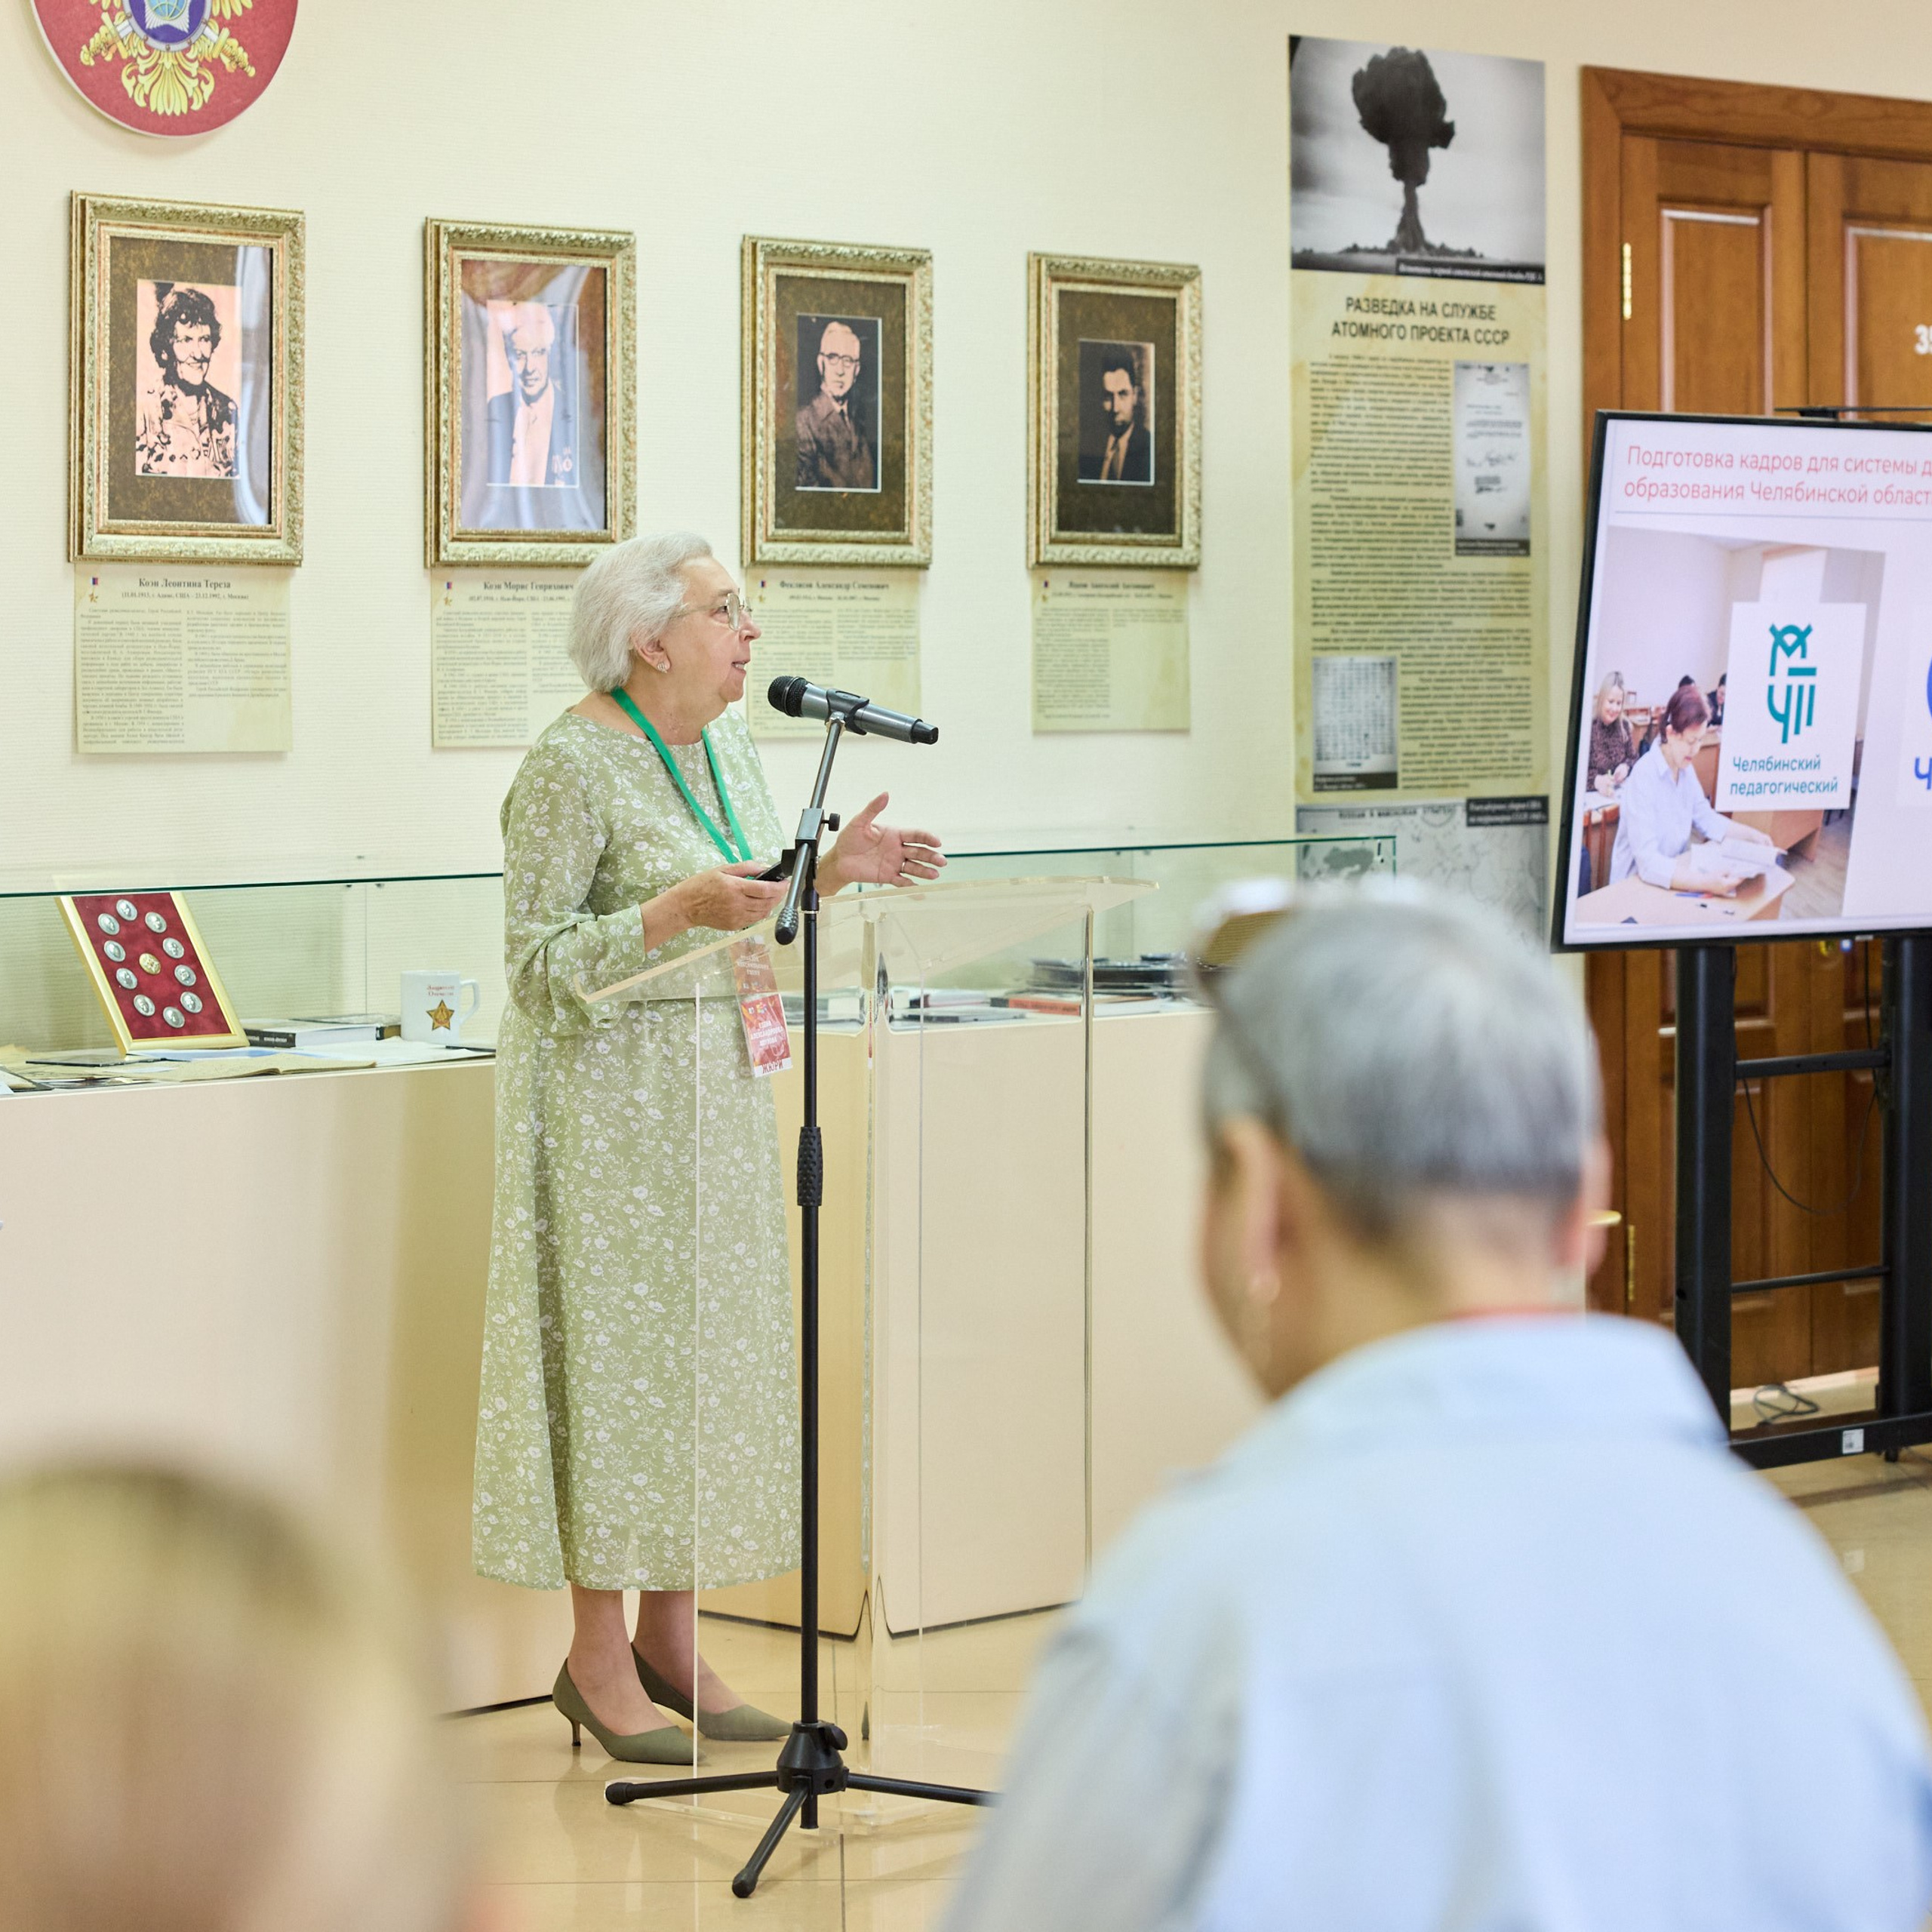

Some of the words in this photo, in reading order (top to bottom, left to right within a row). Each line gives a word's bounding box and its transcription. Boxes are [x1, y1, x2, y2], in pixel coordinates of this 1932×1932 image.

[1346, 297, 1415, 317] РАЗВЕДКА
[1420, 301, 1438, 316] НА
[1441, 303, 1497, 321] СЛУЖБЕ
[1331, 321, 1407, 340] АТОМНОГО
[1411, 325, 1470, 343] ПРОЕКТА
[1474, 329, 1510, 345] СССР
[1627, 445, 1734, 469] Подготовка
[1740, 453, 1803, 474] кадров
[1807, 455, 1839, 473] для
[1844, 457, 1918, 475] системы
[1921, 460, 1932, 477] д
[1624, 476, 1745, 502] образования
[1751, 481, 1868, 503] Челябинской
[1873, 484, 1932, 505] област
[139, 578, 159, 588] Коэн
[161, 578, 202, 589] Леонтина
[204, 579, 231, 590] Тереза
[504, 582, 528, 592] Морис
[1733, 755, 1821, 772] Челябинский
[1914, 757, 1932, 790] Ч
[1730, 777, 1838, 796] педагогический
[762, 1059, 783, 1074] ЖЮРИ
